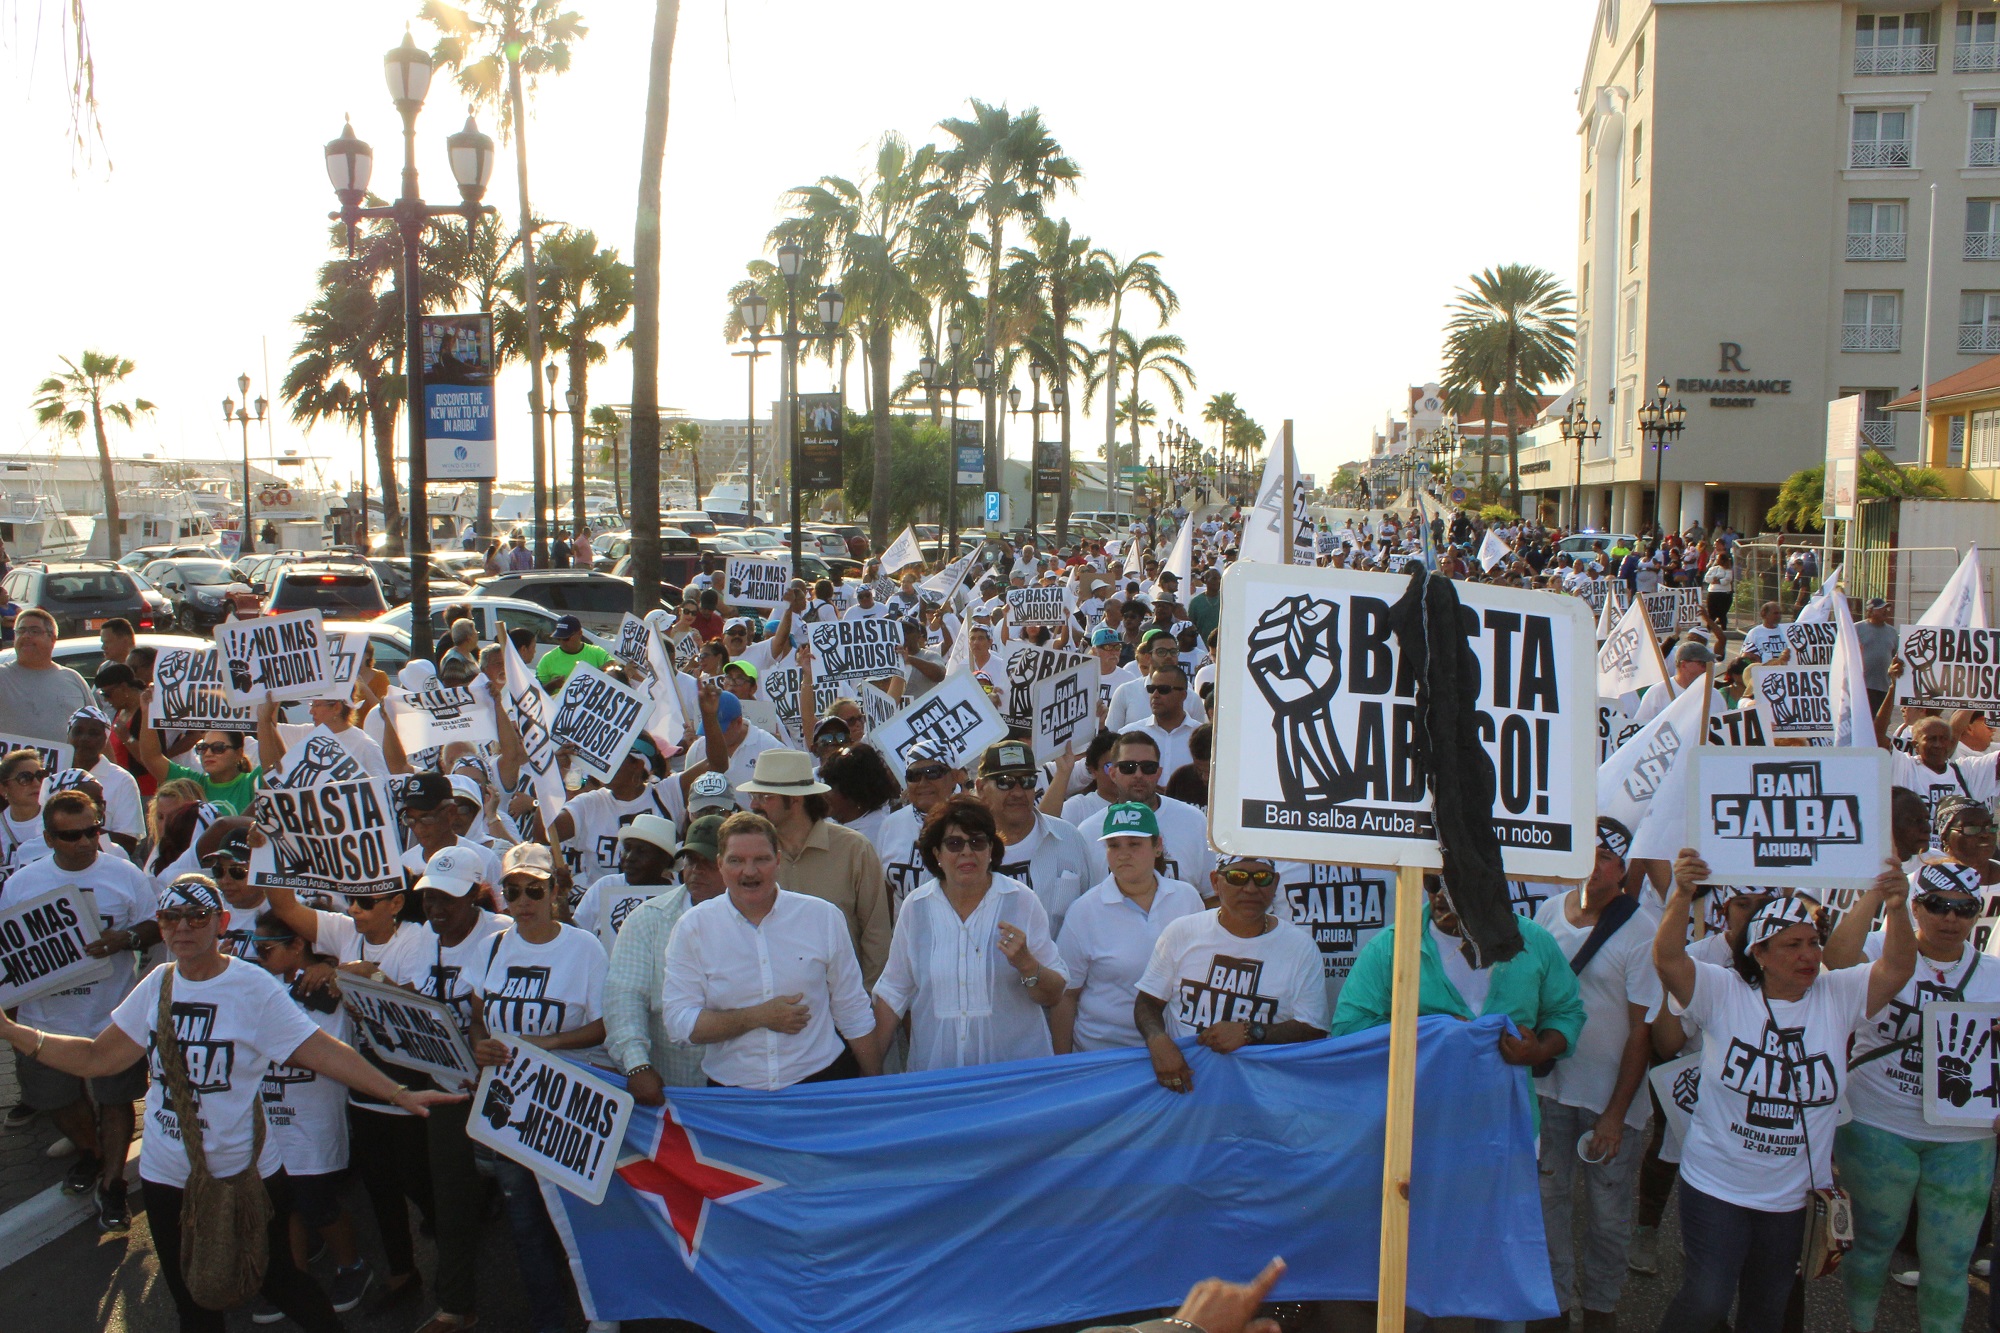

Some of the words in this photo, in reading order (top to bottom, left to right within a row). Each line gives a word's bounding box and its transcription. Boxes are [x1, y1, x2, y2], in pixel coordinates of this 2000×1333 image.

[1718, 342, 1750, 372] R
[1676, 379, 1792, 394] RENAISSANCE
[436, 393, 468, 406] DISCOVER
[470, 392, 483, 405] THE
[1710, 397, 1757, 408] RESORT
[430, 406, 446, 420] NEW
[447, 406, 461, 419] WAY
[462, 406, 471, 419] TO
[472, 405, 489, 419] PLAY
[444, 420, 451, 432] IN
[452, 419, 477, 432] ARUBA!
[988, 494, 996, 509] P
[750, 565, 763, 581] NO
[765, 565, 786, 583] MAS
[1025, 588, 1064, 603] BASTA
[1648, 595, 1675, 613] BASTA
[322, 608, 338, 616] Jeep
[1027, 603, 1062, 620] ABUSO!
[253, 625, 278, 657] NO
[279, 619, 318, 653] MAS
[839, 619, 900, 645] BASTA
[822, 674, 833, 682] Ban
[834, 673, 848, 681] salba
[849, 672, 863, 680] Aruba
[404, 687, 474, 710] SALBA
[1056, 683, 1075, 702] BAN
[583, 679, 643, 733] BASTA
[1042, 693, 1088, 733] SALBA
[1907, 698, 1921, 706] Ban
[1922, 699, 1940, 707] salba
[1942, 699, 1961, 708] Aruba
[1968, 701, 1996, 709] Eleccion
[211, 721, 234, 729] Eleccion
[911, 705, 944, 735] BAN
[569, 710, 625, 761] ABUSO!
[1055, 725, 1073, 740] ARUBA
[1758, 773, 1812, 797] BAN
[273, 782, 385, 836] BASTA
[1716, 799, 1857, 837] SALBA
[1265, 805, 1302, 827] Ban
[1307, 806, 1356, 830] salba
[1361, 810, 1415, 834] Aruba
[1511, 824, 1552, 845] nobo
[293, 829, 391, 881] ABUSO!
[1758, 843, 1811, 857] ARUBA
[266, 874, 284, 885] Ban
[285, 876, 308, 888] salba
[308, 878, 330, 889] Aruba
[338, 882, 370, 893] Eleccion
[372, 881, 395, 892] nobo
[1314, 864, 1353, 884] BAN
[1922, 864, 1956, 891] ARUBA
[1288, 885, 1382, 923] SALBA
[22, 897, 78, 942] MAS
[1315, 928, 1353, 942] ARUBA
[504, 977, 542, 999] BAN
[1210, 965, 1253, 995] BAN
[378, 999, 408, 1027] NO
[402, 1005, 451, 1040] MAS
[1724, 1045, 1834, 1103] SALBA
[1886, 1067, 1920, 1084] MARCHA
[531, 1065, 567, 1111] NO
[565, 1081, 618, 1139] MAS
[1751, 1102, 1794, 1119] ARUBA
[1731, 1122, 1766, 1143] MARCHA
[1743, 1139, 1797, 1157] 12-04-2019
